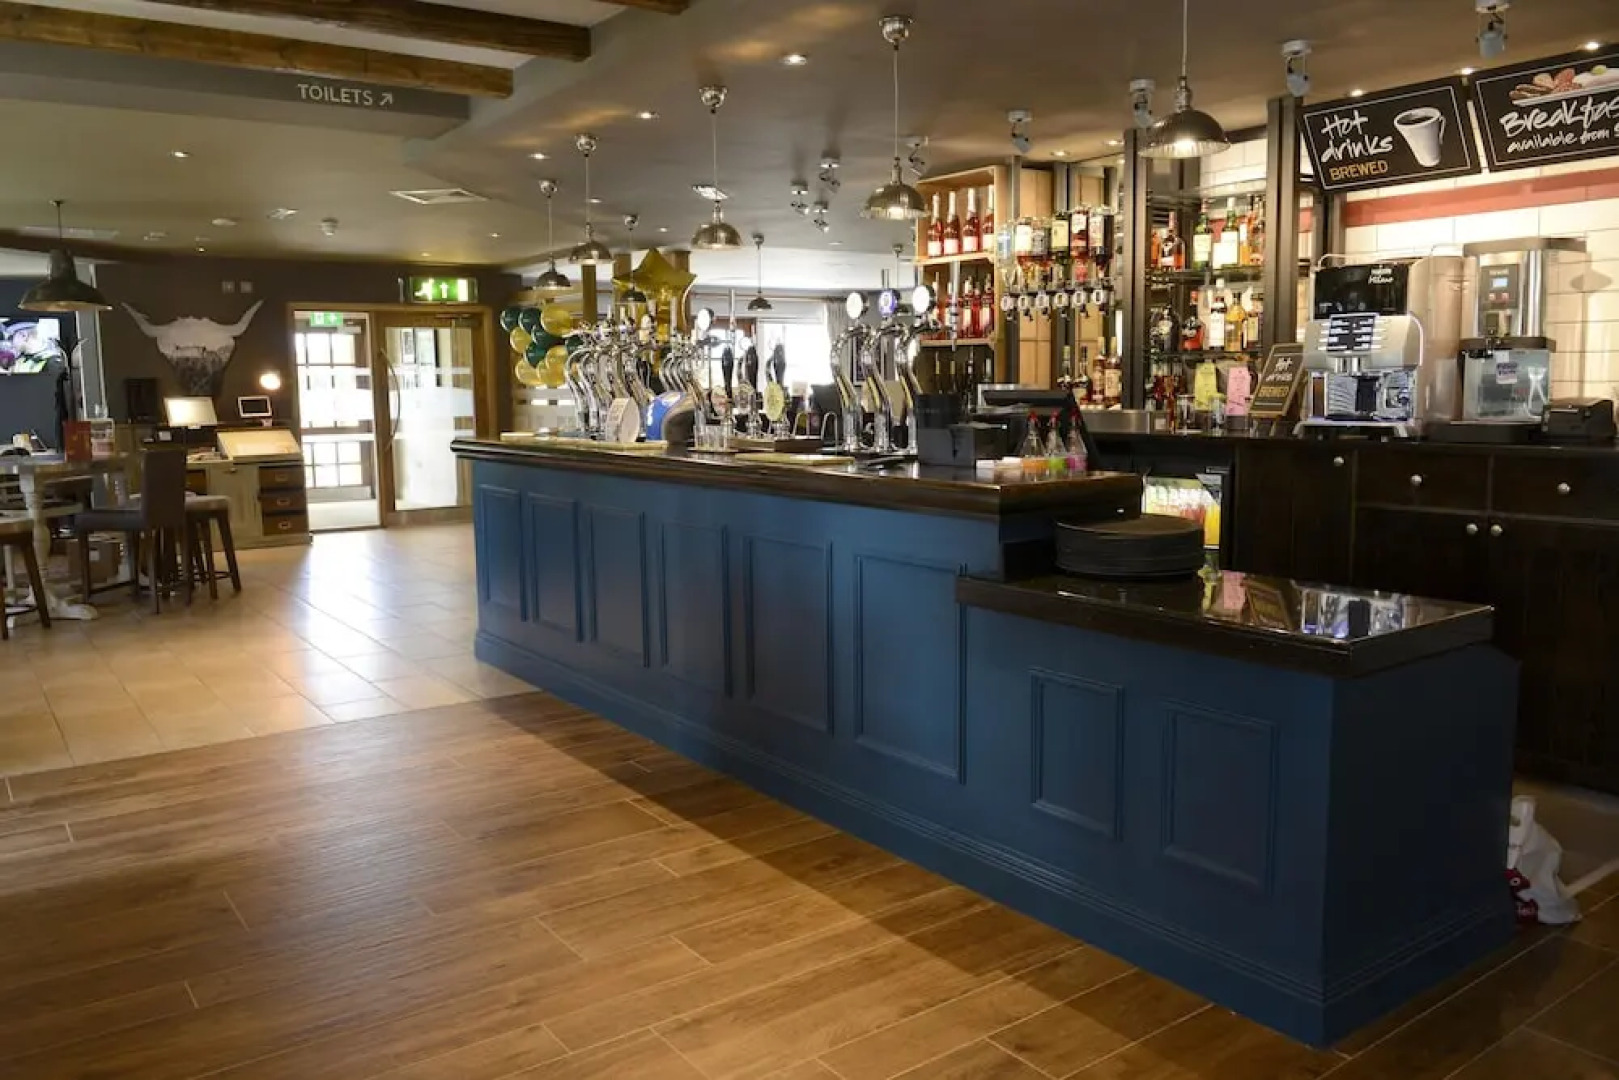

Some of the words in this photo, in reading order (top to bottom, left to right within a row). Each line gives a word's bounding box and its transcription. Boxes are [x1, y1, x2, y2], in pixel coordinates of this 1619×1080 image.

[297, 83, 373, 106] TOILETS
[1321, 109, 1369, 139] Hot
[1321, 134, 1393, 162] drinks
[1506, 130, 1578, 153] available
[1580, 129, 1610, 145] from
[1329, 160, 1389, 180] BREWED
